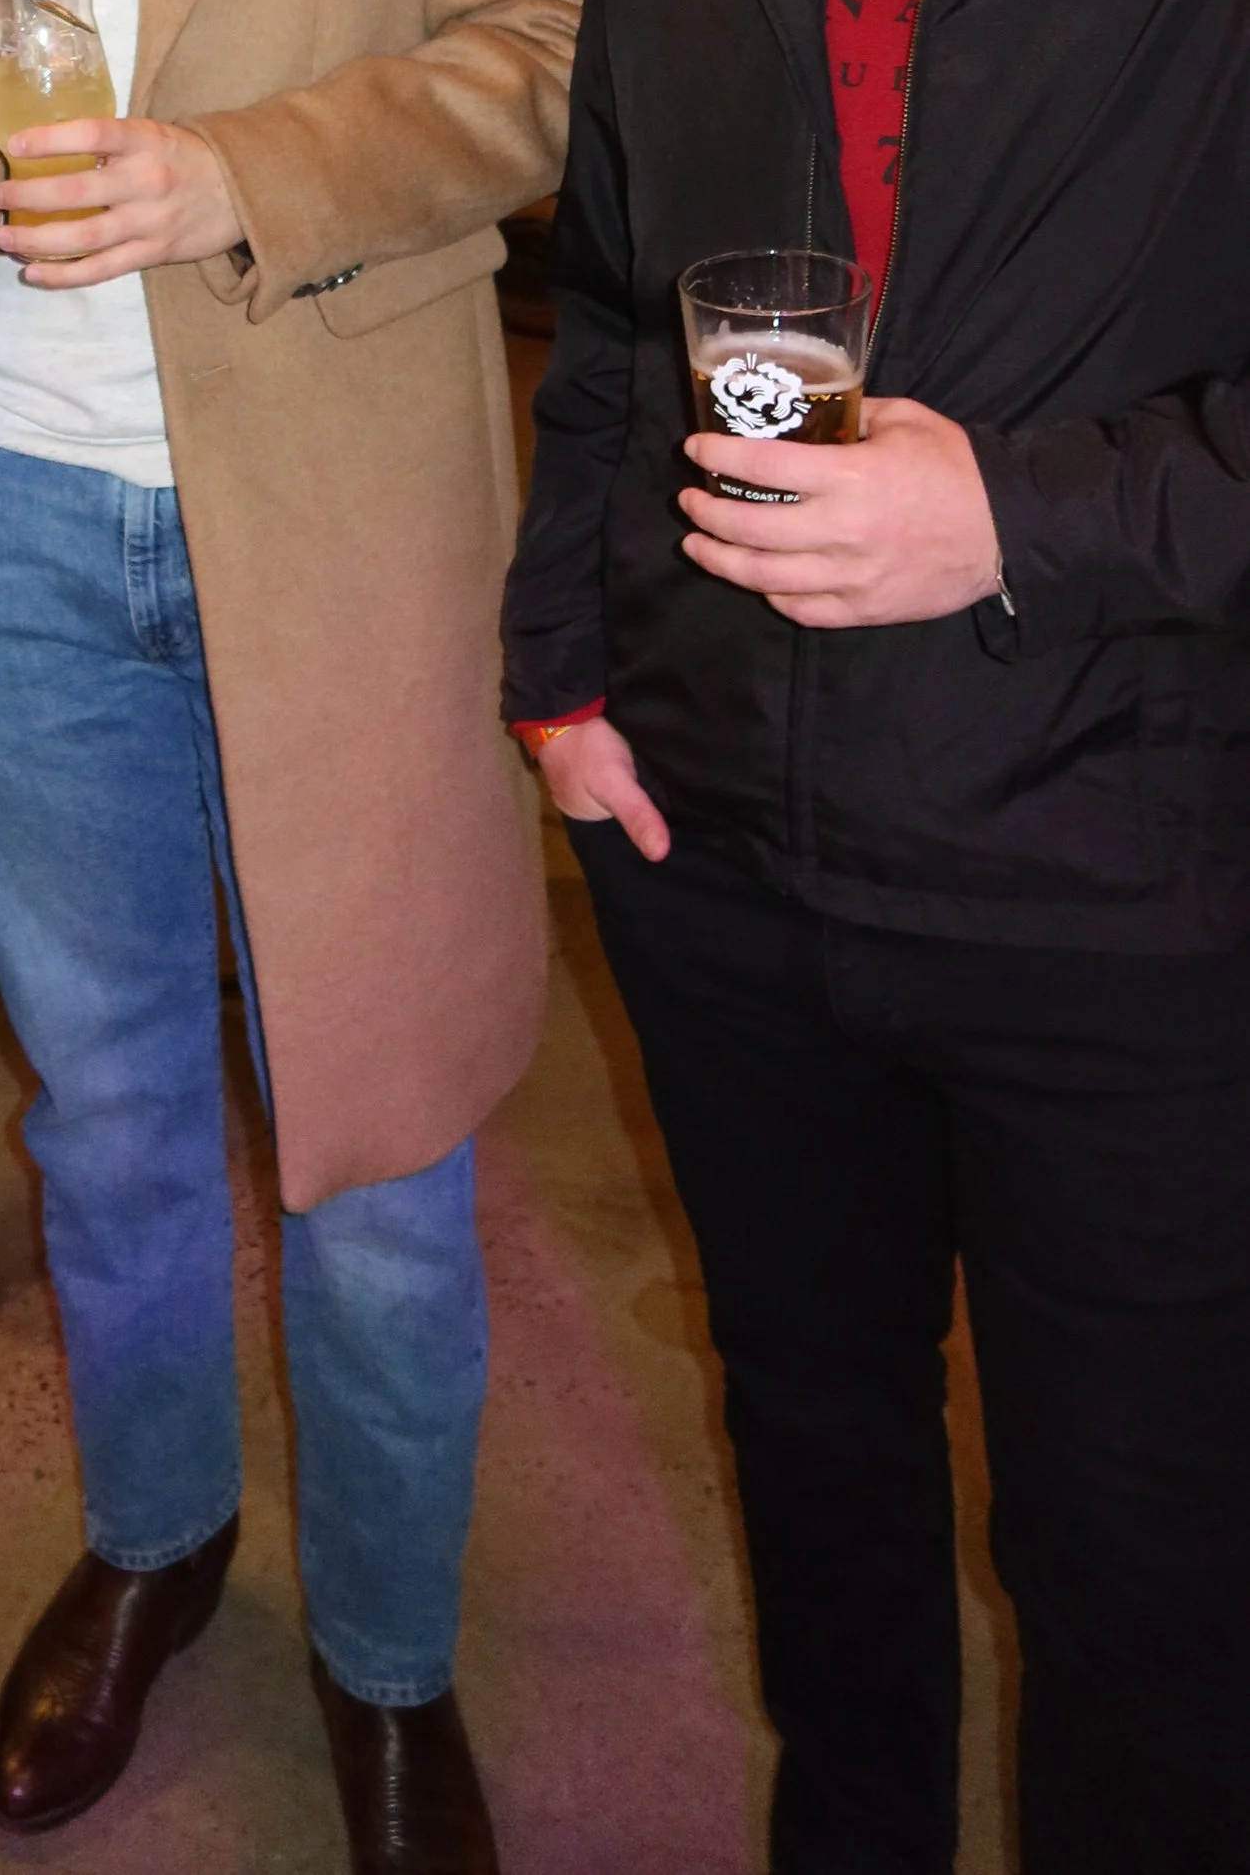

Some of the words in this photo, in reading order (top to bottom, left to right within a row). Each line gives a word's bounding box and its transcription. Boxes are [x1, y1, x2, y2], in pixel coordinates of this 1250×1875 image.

[720, 483, 742, 496] WEST
[745, 490, 780, 502] COAST
[783, 494, 800, 503] IPA
